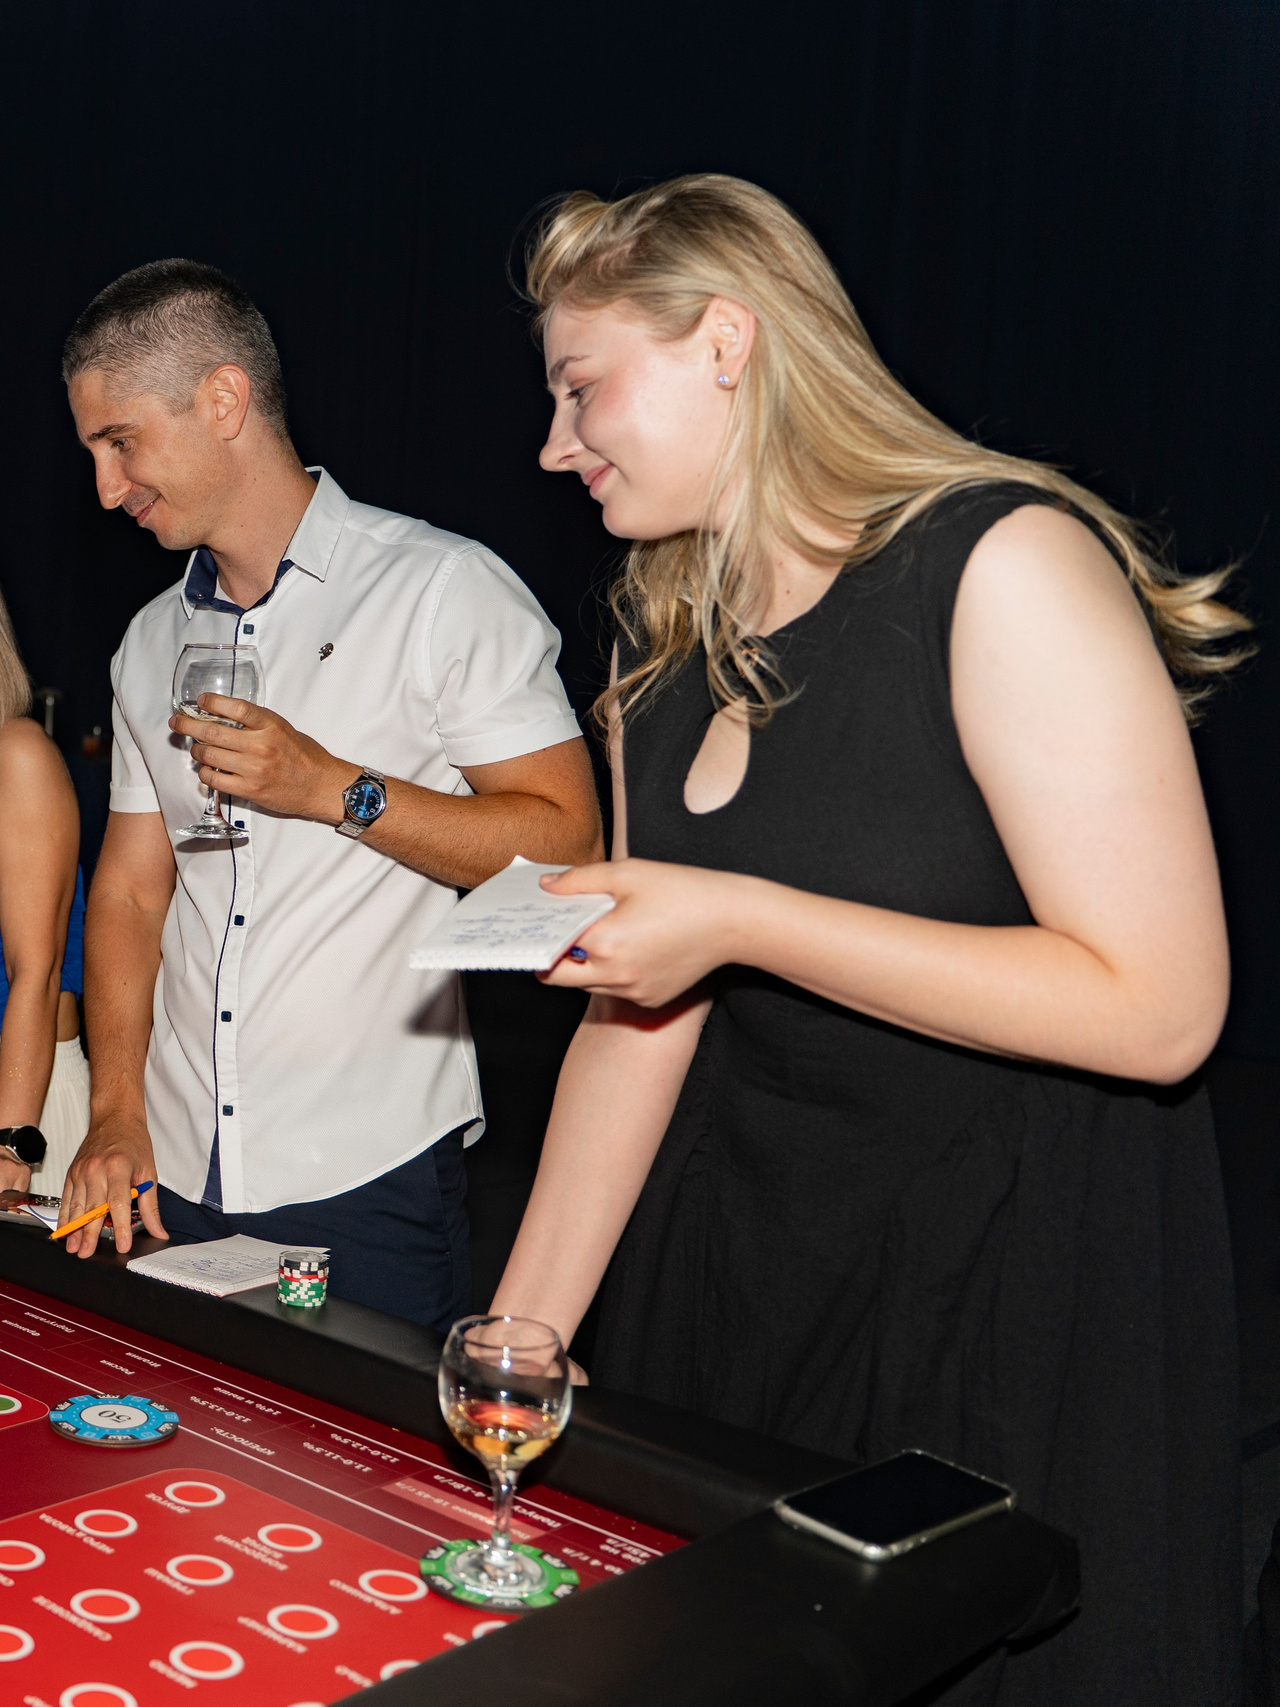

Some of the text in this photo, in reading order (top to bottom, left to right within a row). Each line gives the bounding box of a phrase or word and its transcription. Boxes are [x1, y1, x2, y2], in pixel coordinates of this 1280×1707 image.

[2, 1320, 40, 1336] Франция
[24, 1312, 75, 1333] Португалия
[100, 1360, 135, 1375] Россия
[125, 1352, 161, 1367] Италия
[213, 1387, 245, 1400] выше
[98, 1409, 132, 1424] 50
[190, 1396, 251, 1422] 13.0-13.5%
[256, 1404, 281, 1415] 14%
[211, 1427, 275, 1455] КРЕПОСТЬ:
[331, 1433, 399, 1463] 12.0-12.5%
[303, 1442, 372, 1472] 11.0-11.5%
